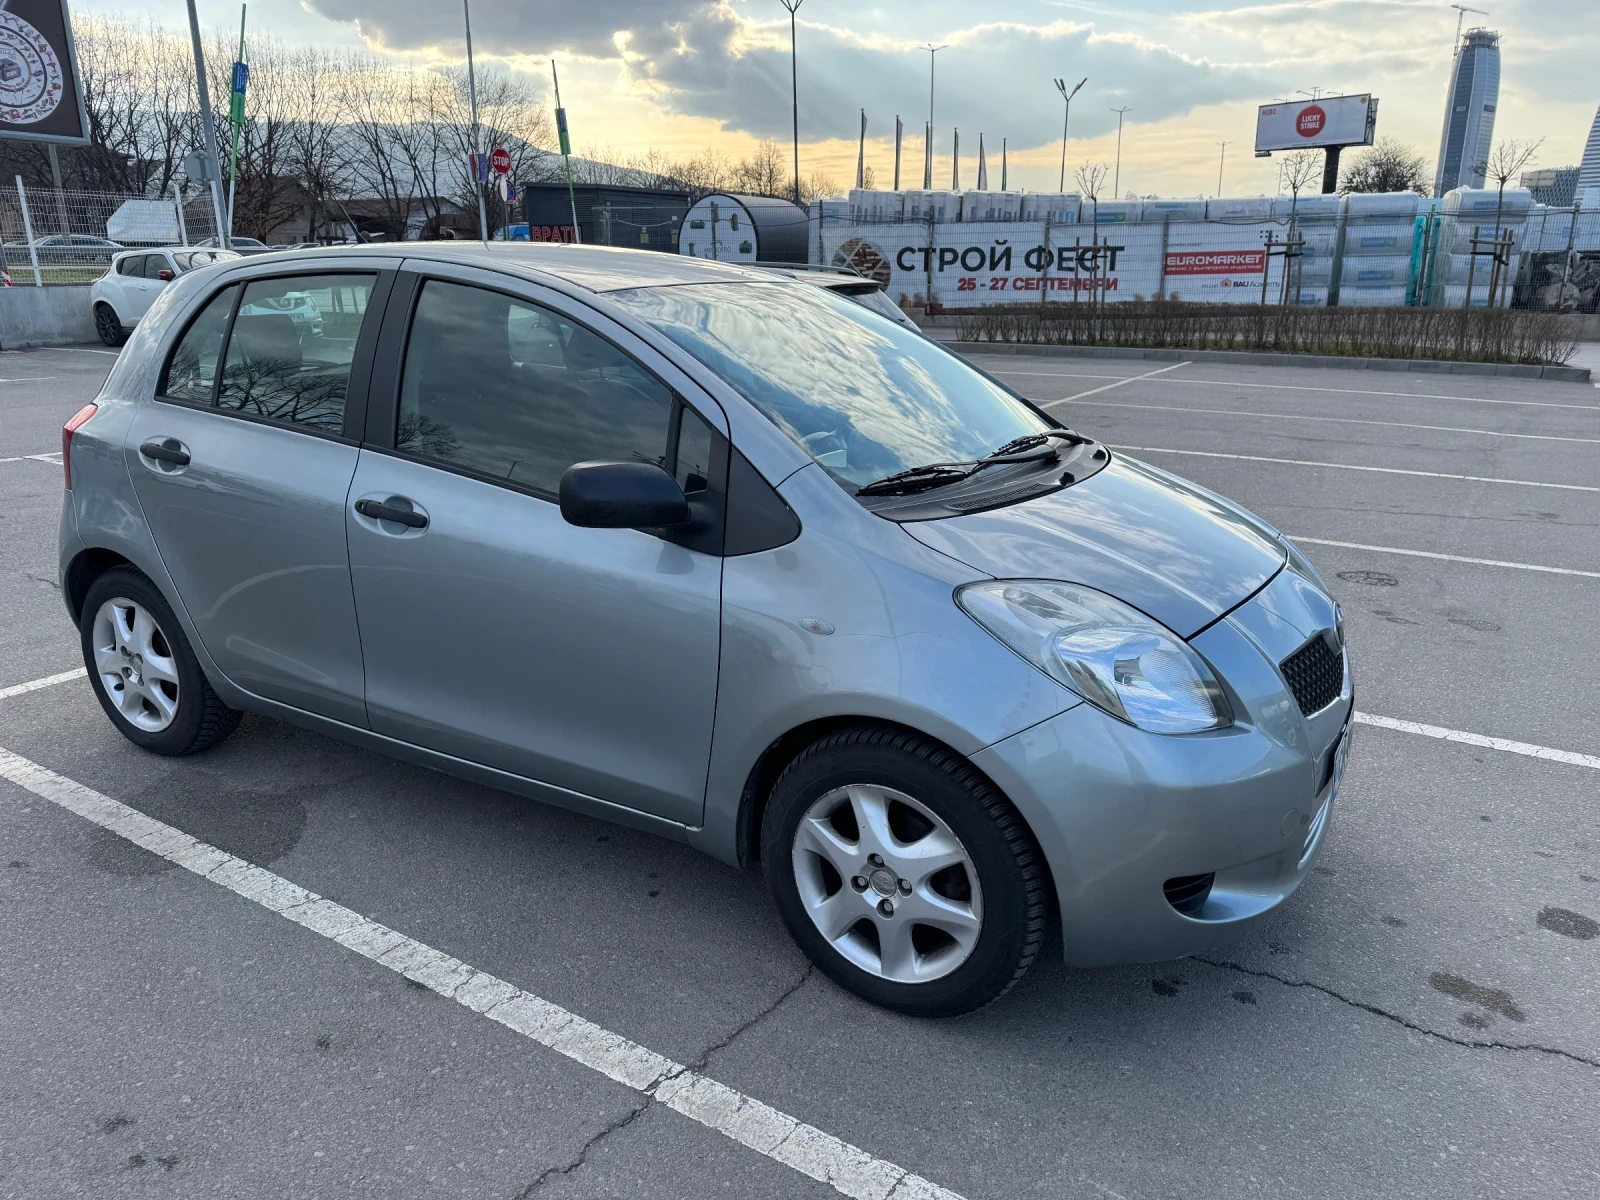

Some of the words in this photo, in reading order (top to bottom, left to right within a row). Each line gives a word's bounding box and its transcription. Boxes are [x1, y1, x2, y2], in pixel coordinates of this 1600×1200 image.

[1302, 114, 1321, 122] LUCKY
[1300, 121, 1320, 130] STRIKE
[493, 155, 509, 167] STOP
[532, 226, 582, 243] ВРАТИ
[896, 239, 1012, 272] СТРОЙ
[1024, 245, 1125, 272] ФЕСТ
[1166, 254, 1262, 266] EUROMARKET
[957, 277, 976, 291] 25
[989, 277, 1008, 291] 27
[1012, 277, 1118, 291] СЕПТЕМВРИ
[1233, 280, 1249, 288] BAU
[1249, 280, 1280, 289] Acaemy
